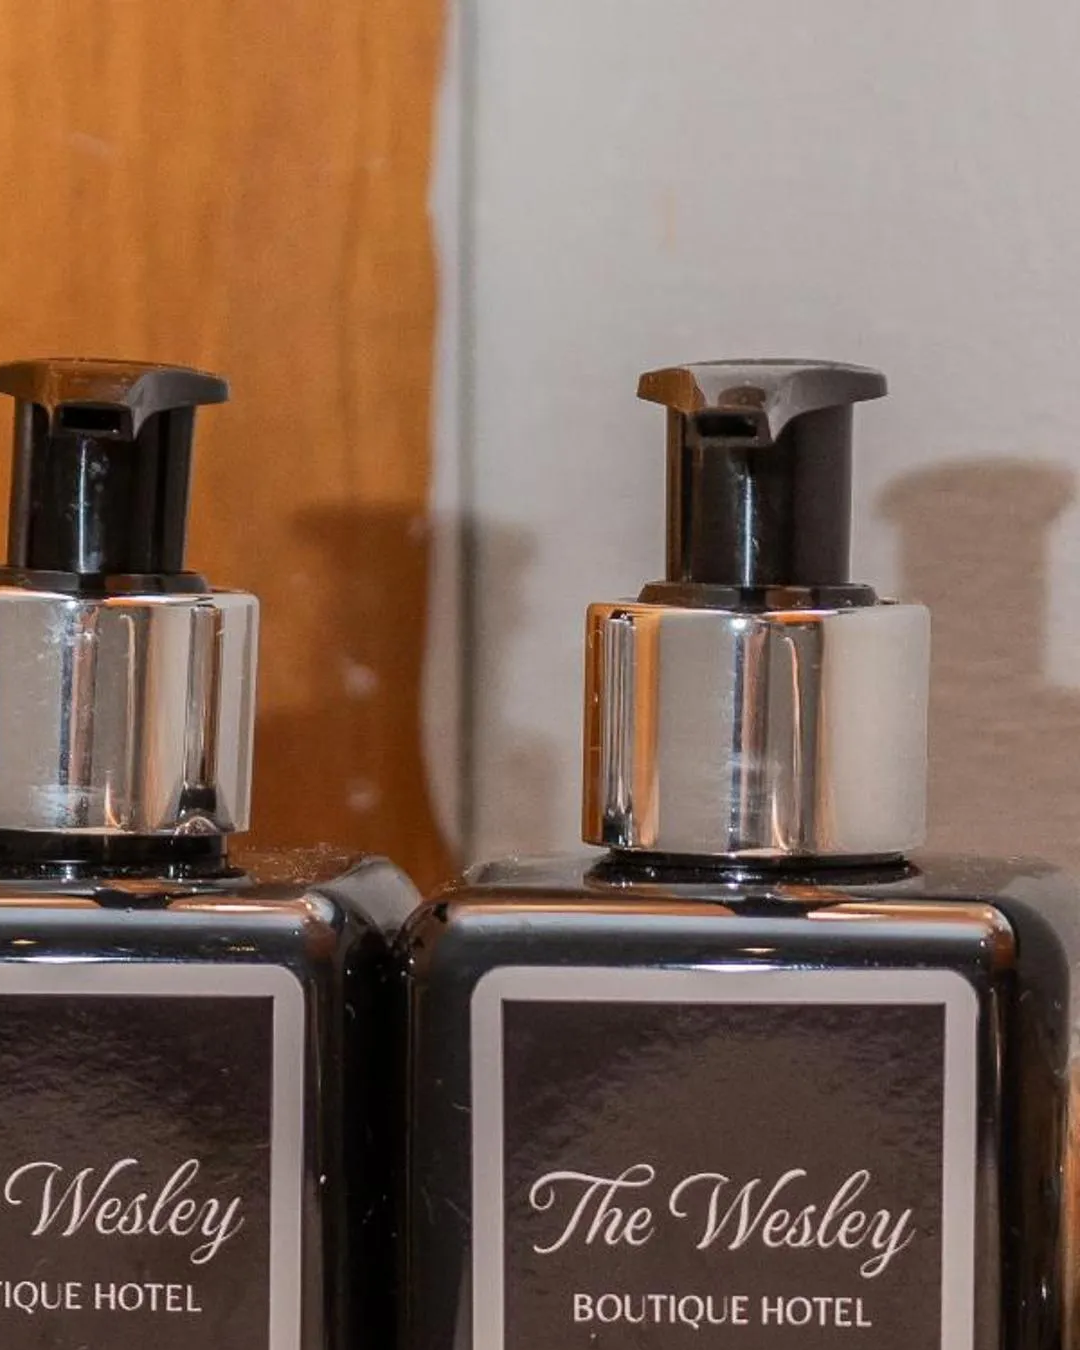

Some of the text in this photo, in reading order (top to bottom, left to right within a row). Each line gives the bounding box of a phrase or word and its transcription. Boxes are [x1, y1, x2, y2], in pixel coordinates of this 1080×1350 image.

[4, 1158, 241, 1265] Wesley
[528, 1163, 912, 1279] The Wesley
[94, 1282, 202, 1312] HOTEL
[573, 1293, 872, 1330] BOUTIQUE HOTEL
